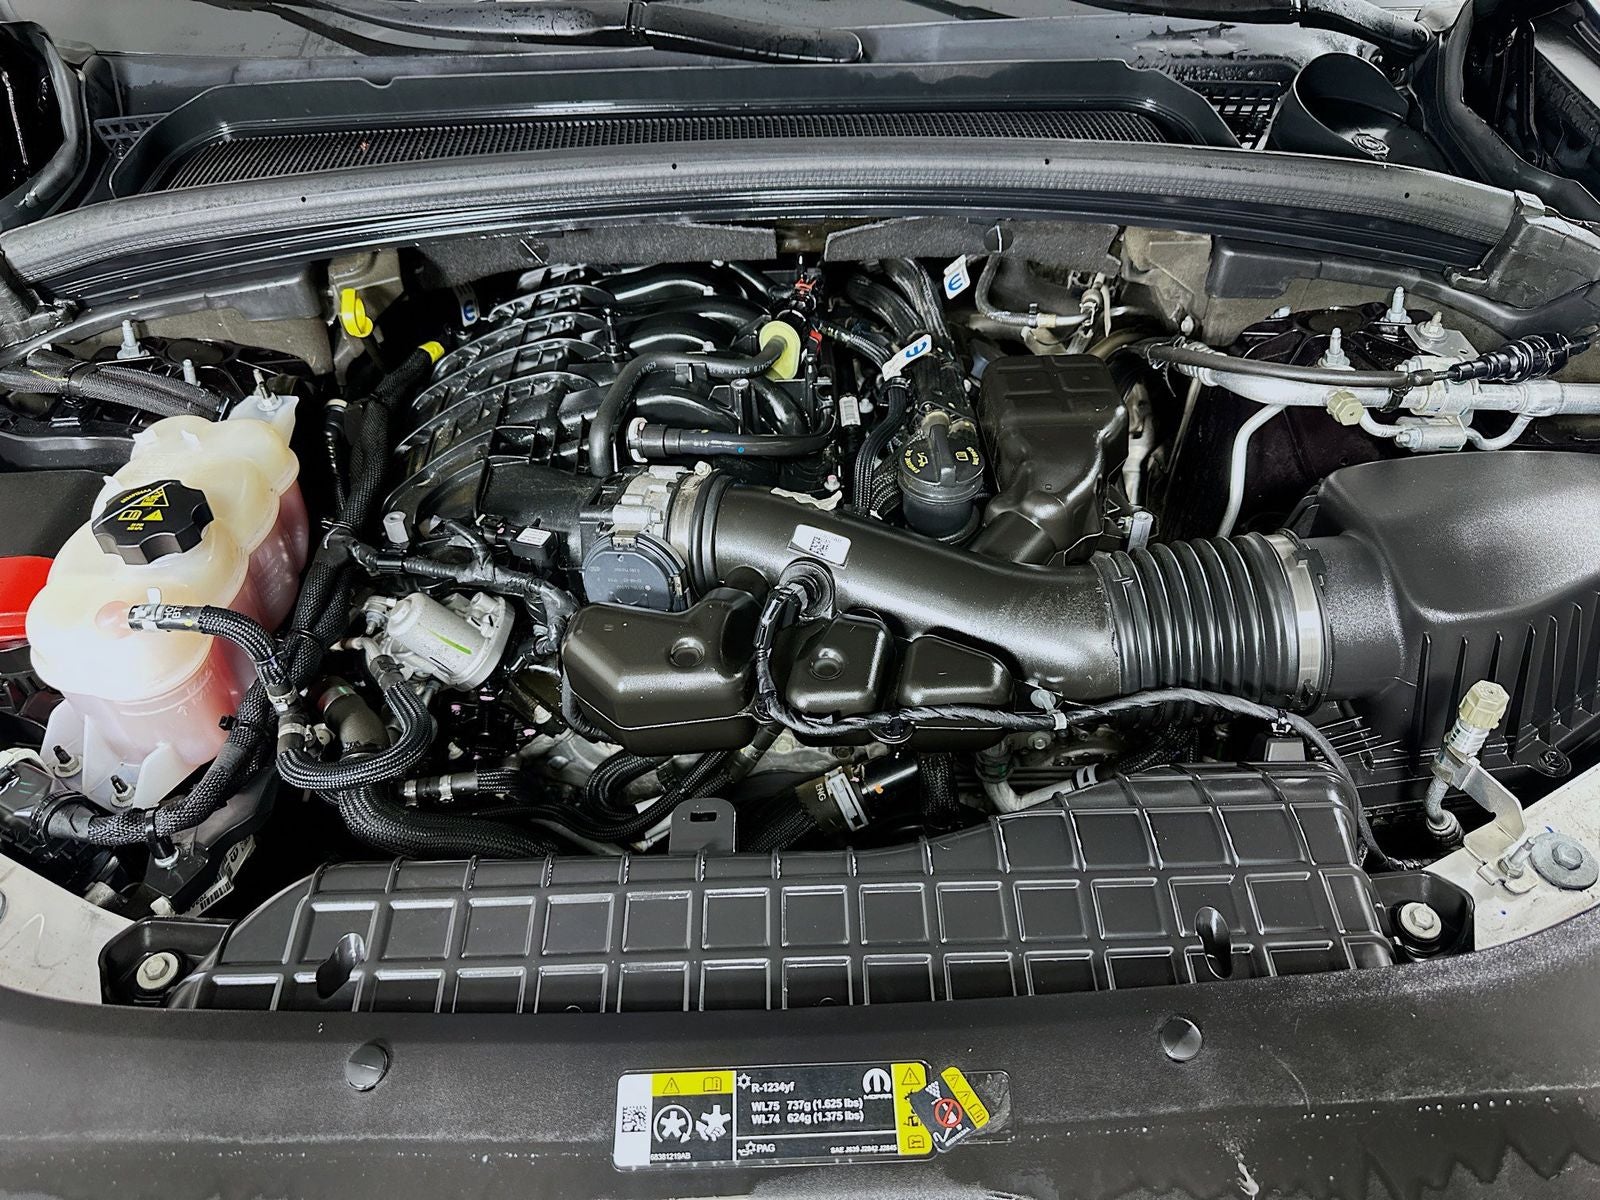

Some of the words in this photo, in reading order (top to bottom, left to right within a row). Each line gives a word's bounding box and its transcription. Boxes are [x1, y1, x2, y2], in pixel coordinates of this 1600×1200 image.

[815, 783, 827, 802] ENG
[751, 1081, 795, 1093] R-1234yf
[751, 1101, 780, 1111] WL75
[786, 1100, 811, 1111] 737g
[813, 1099, 842, 1111] (1.625
[844, 1098, 864, 1110] lbs)
[751, 1114, 780, 1124] WL74
[786, 1113, 812, 1124] 624g
[813, 1112, 843, 1123] (1.375
[845, 1111, 865, 1122] lbs)
[757, 1143, 776, 1153] PAG
